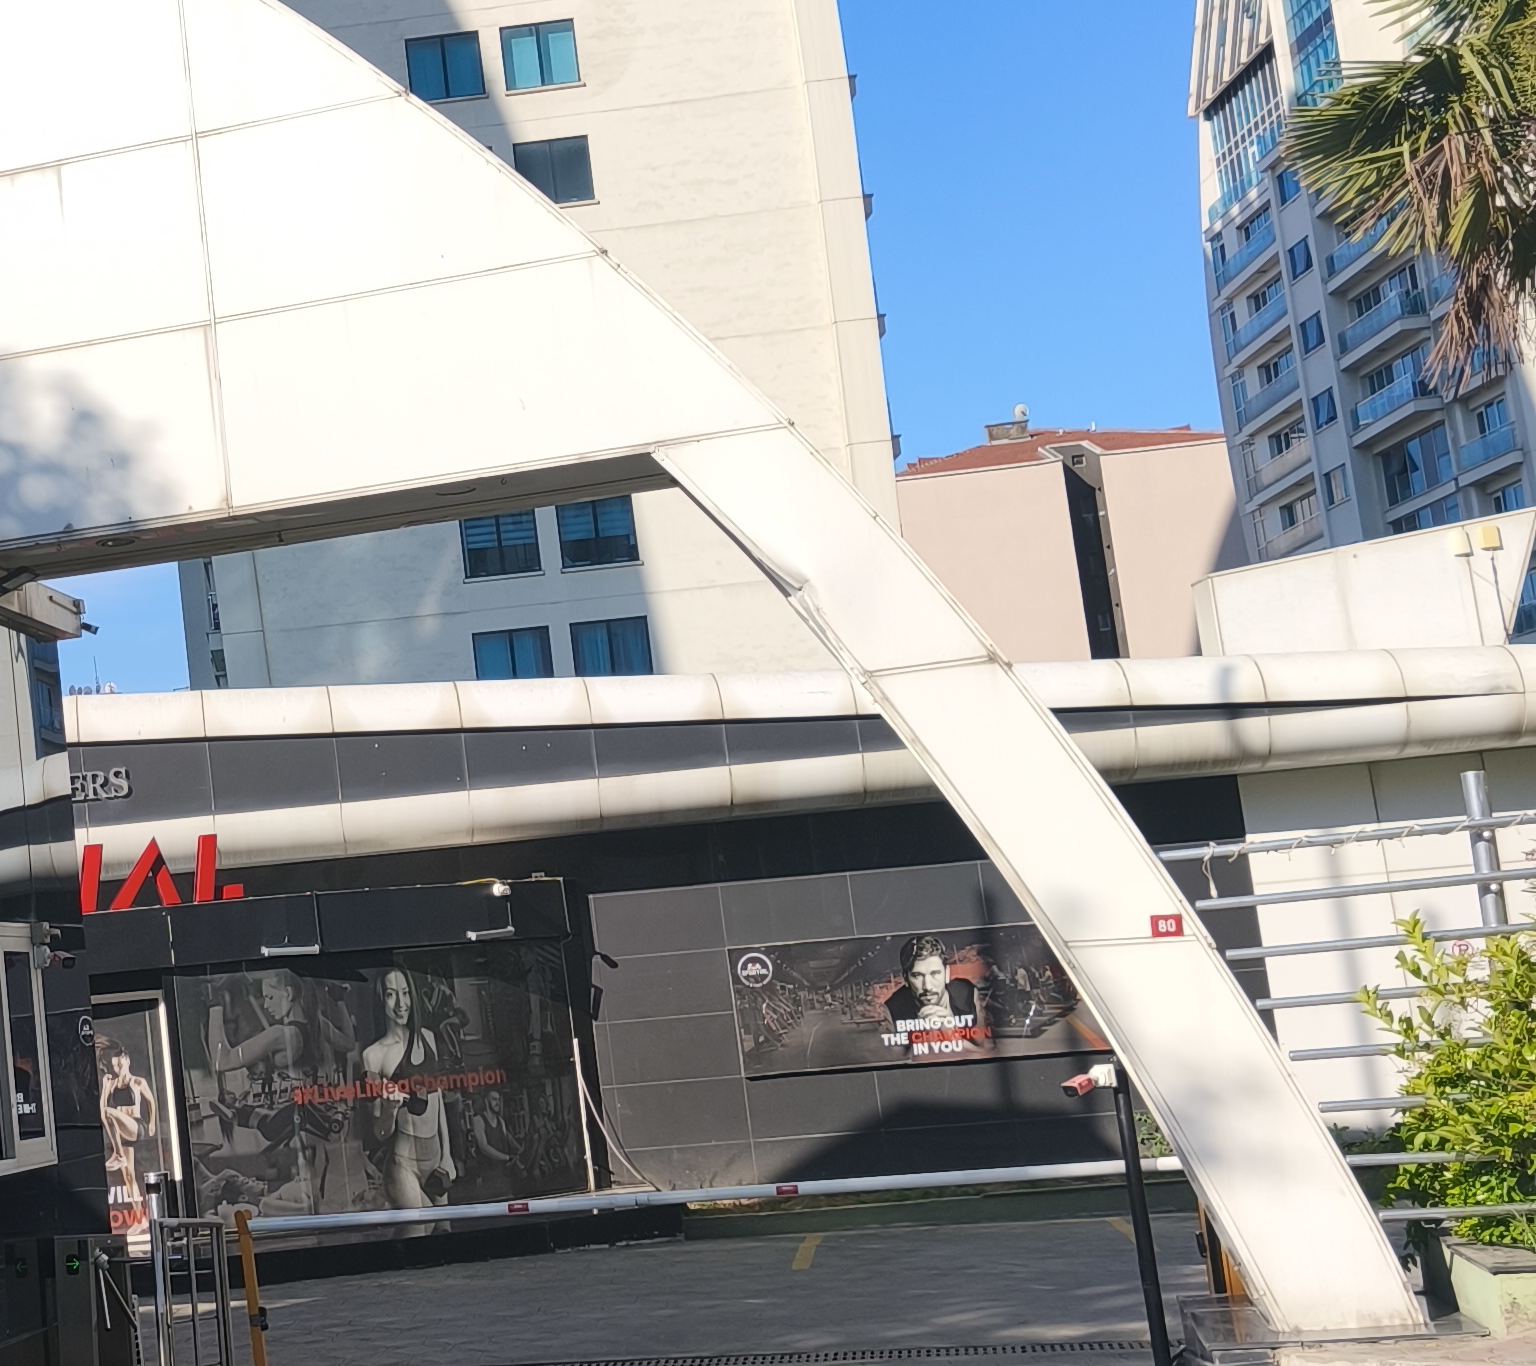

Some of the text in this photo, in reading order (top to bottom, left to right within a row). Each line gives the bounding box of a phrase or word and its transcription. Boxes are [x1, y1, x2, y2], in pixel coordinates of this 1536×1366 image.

[1158, 919, 1177, 933] 80
[896, 1014, 974, 1032] BRING OUT
[881, 1025, 993, 1046] THE CHAMPION
[912, 1039, 963, 1055] IN YOU
